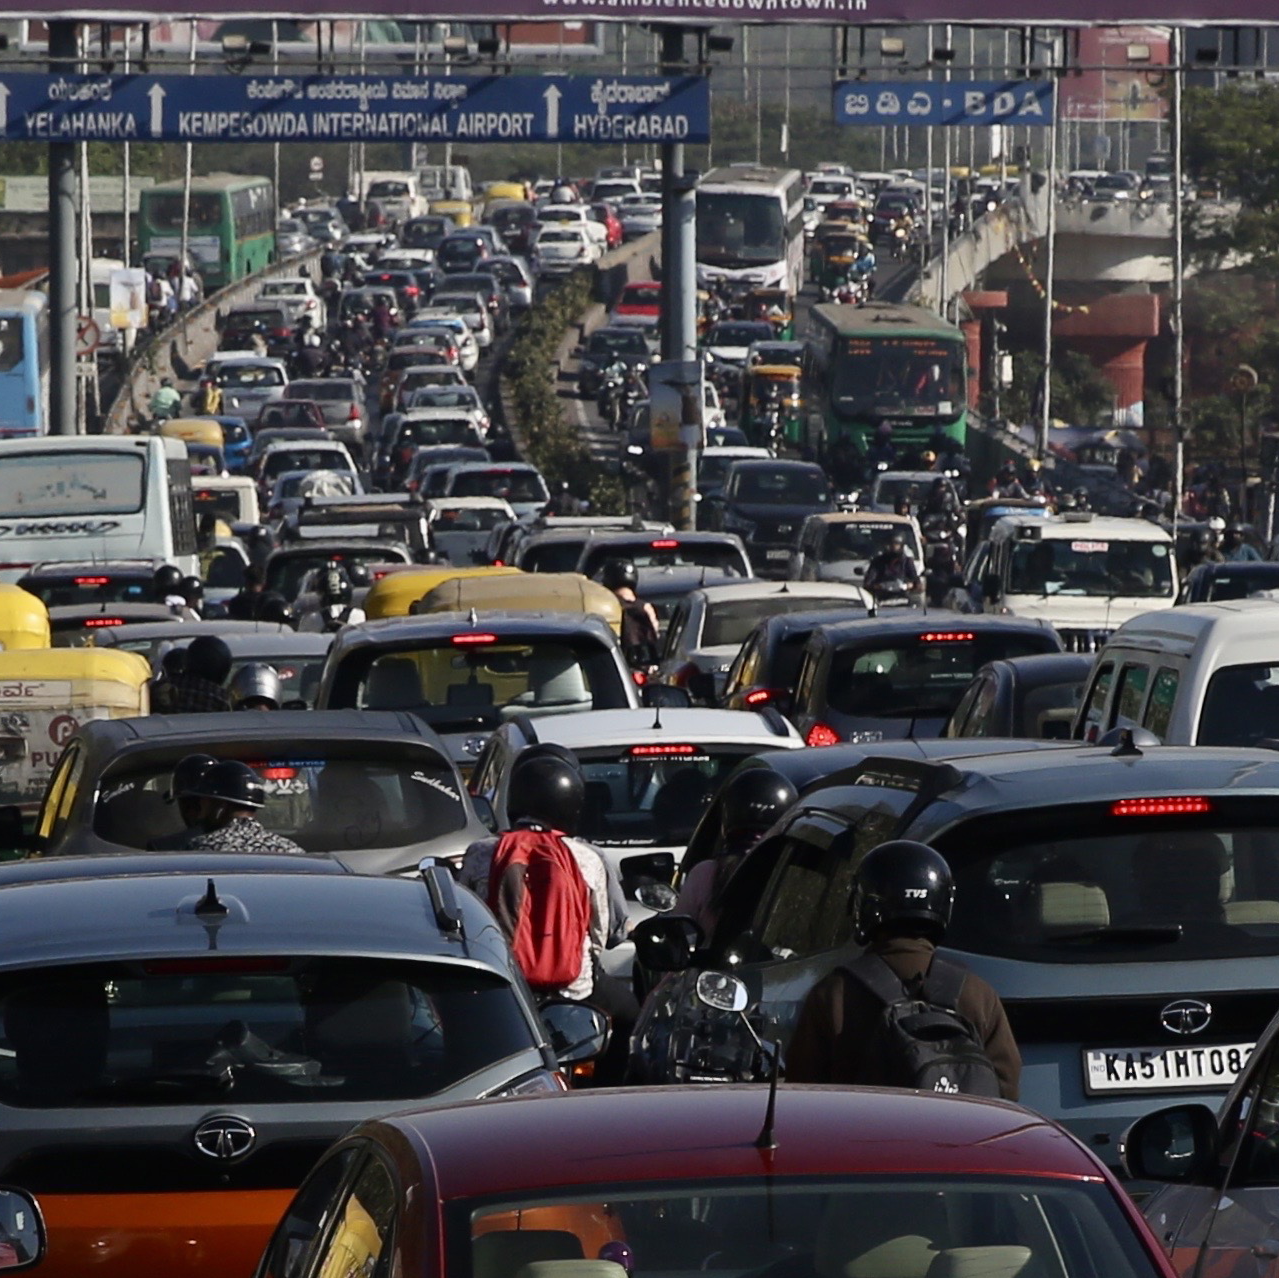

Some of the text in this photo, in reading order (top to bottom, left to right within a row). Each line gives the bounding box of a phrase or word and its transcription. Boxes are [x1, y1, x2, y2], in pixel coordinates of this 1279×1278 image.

[964, 91, 1044, 116] BDA
[25, 112, 137, 138] YELAHANKA
[178, 112, 534, 138] KEMPEGOWDA INTERNATIONAL AIRPORT
[573, 114, 689, 140] HYDERABAD
[904, 888, 928, 899] TVS
[1090, 1063, 1106, 1074] IND
